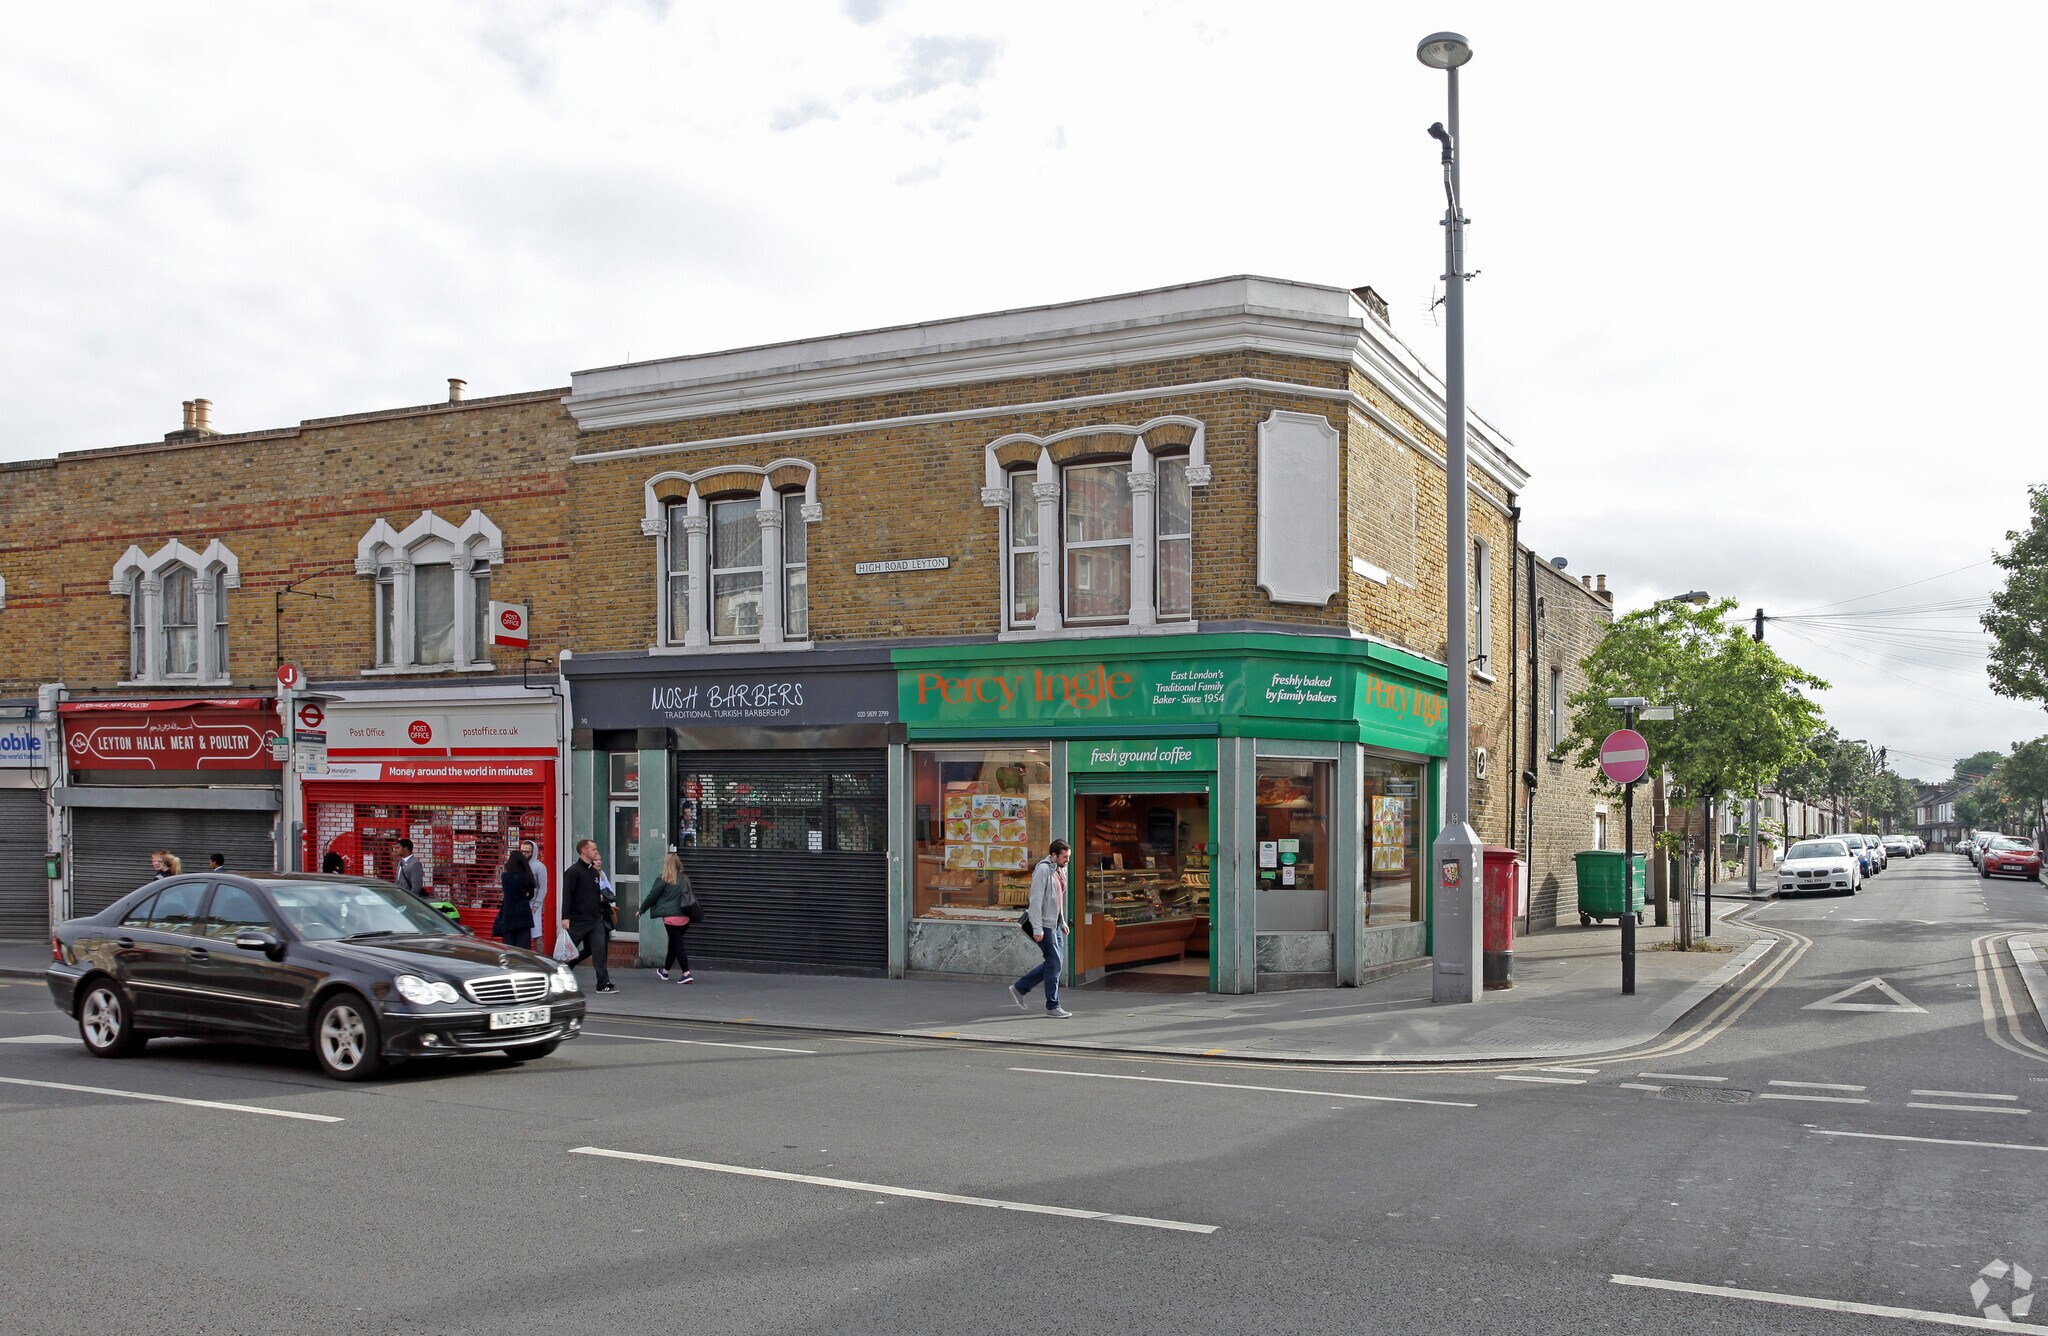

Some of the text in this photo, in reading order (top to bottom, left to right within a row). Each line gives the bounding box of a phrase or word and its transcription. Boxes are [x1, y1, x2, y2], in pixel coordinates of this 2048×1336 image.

[858, 558, 945, 573] HIGH ROAD LEYTON
[503, 619, 519, 627] OFFICE
[284, 668, 293, 683] J
[1170, 669, 1224, 680] East London's
[1271, 673, 1333, 689] freshly baked
[917, 664, 1133, 711] Percy Ingle
[1155, 680, 1224, 694] Traditional Family
[651, 683, 804, 710] MOSH BARBERS
[1153, 694, 1176, 704] Baker
[1181, 694, 1201, 704] Since
[1203, 693, 1225, 703] 1954
[1265, 688, 1338, 705] by family bakers
[1366, 673, 1447, 727] Percy Ingle
[664, 709, 790, 719] TRADITIONAL TURKISH BARBERSHOP
[349, 728, 385, 737] Post Office
[462, 726, 519, 737] postoffice.co.uk
[0, 732, 41, 751] obile
[98, 735, 249, 750] LEYTON HALAL MEAT & POULTRY
[1090, 746, 1192, 767] fresh ground coffee
[389, 765, 533, 778] Money around the world in minutes
